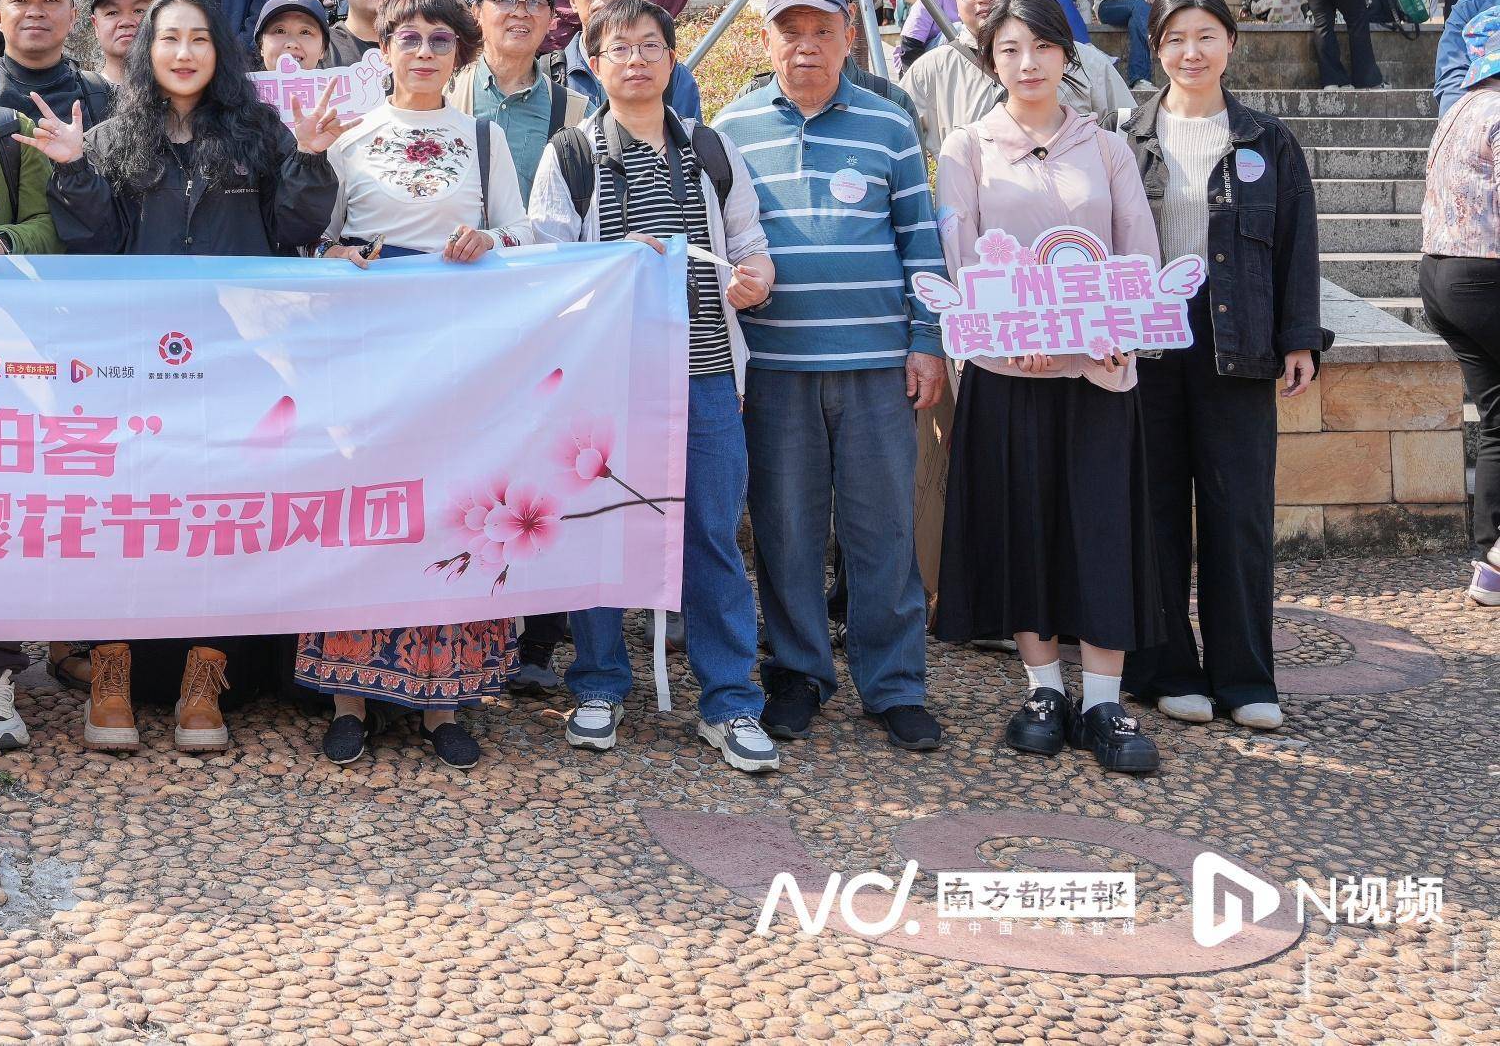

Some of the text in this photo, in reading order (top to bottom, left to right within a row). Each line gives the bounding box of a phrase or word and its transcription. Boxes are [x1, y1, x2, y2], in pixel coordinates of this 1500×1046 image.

[1222, 169, 1232, 203] alexander
[964, 260, 1155, 309] 广州宝藏
[946, 302, 1186, 354] 樱花打卡点
[97, 365, 134, 379] N视频
